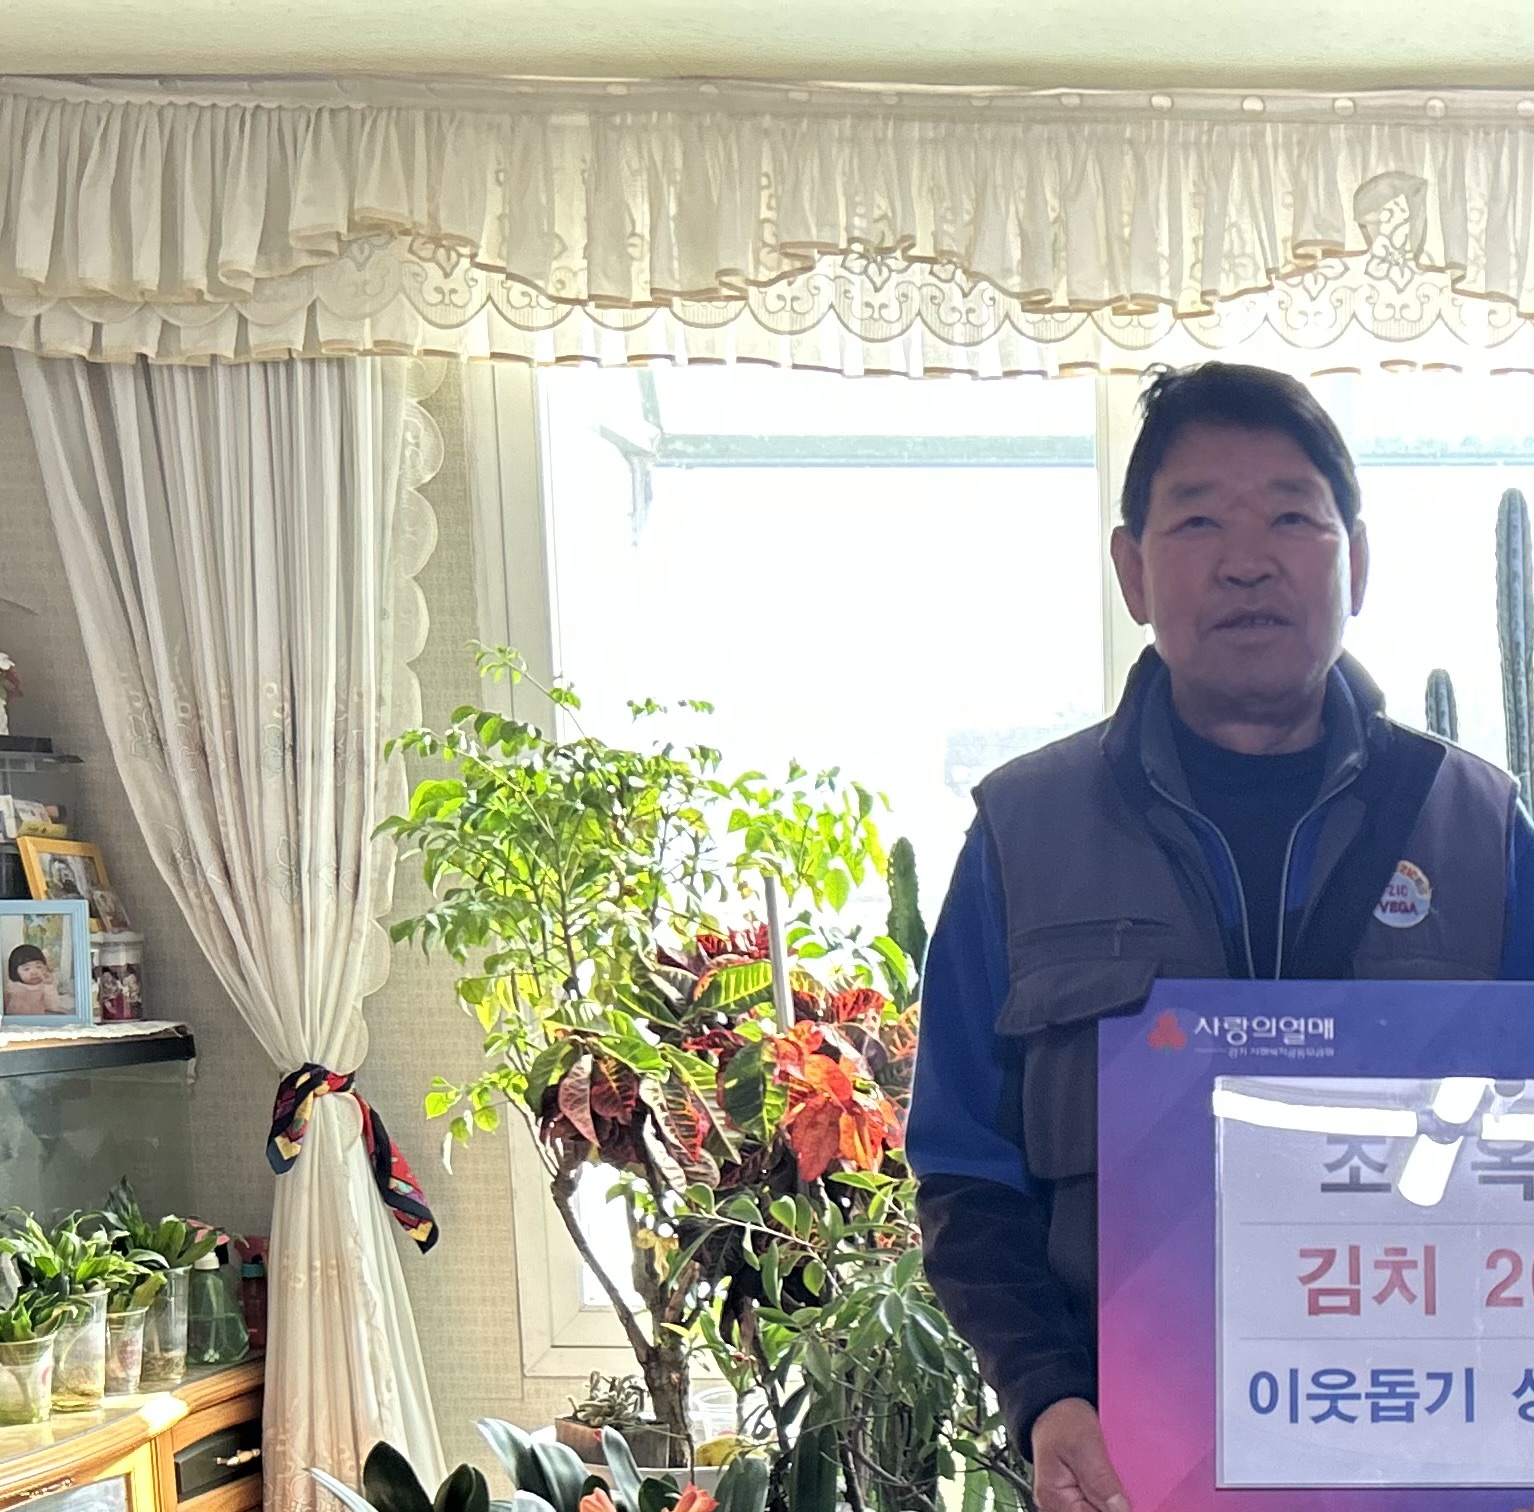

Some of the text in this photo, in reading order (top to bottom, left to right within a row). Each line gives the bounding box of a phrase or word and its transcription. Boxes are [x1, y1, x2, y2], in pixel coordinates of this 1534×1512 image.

[1194, 1016, 1335, 1046] 사랑의열매
[1320, 1136, 1392, 1193] 조
[1298, 1244, 1437, 1317] 김치
[1248, 1367, 1475, 1424] 이웃돕기
